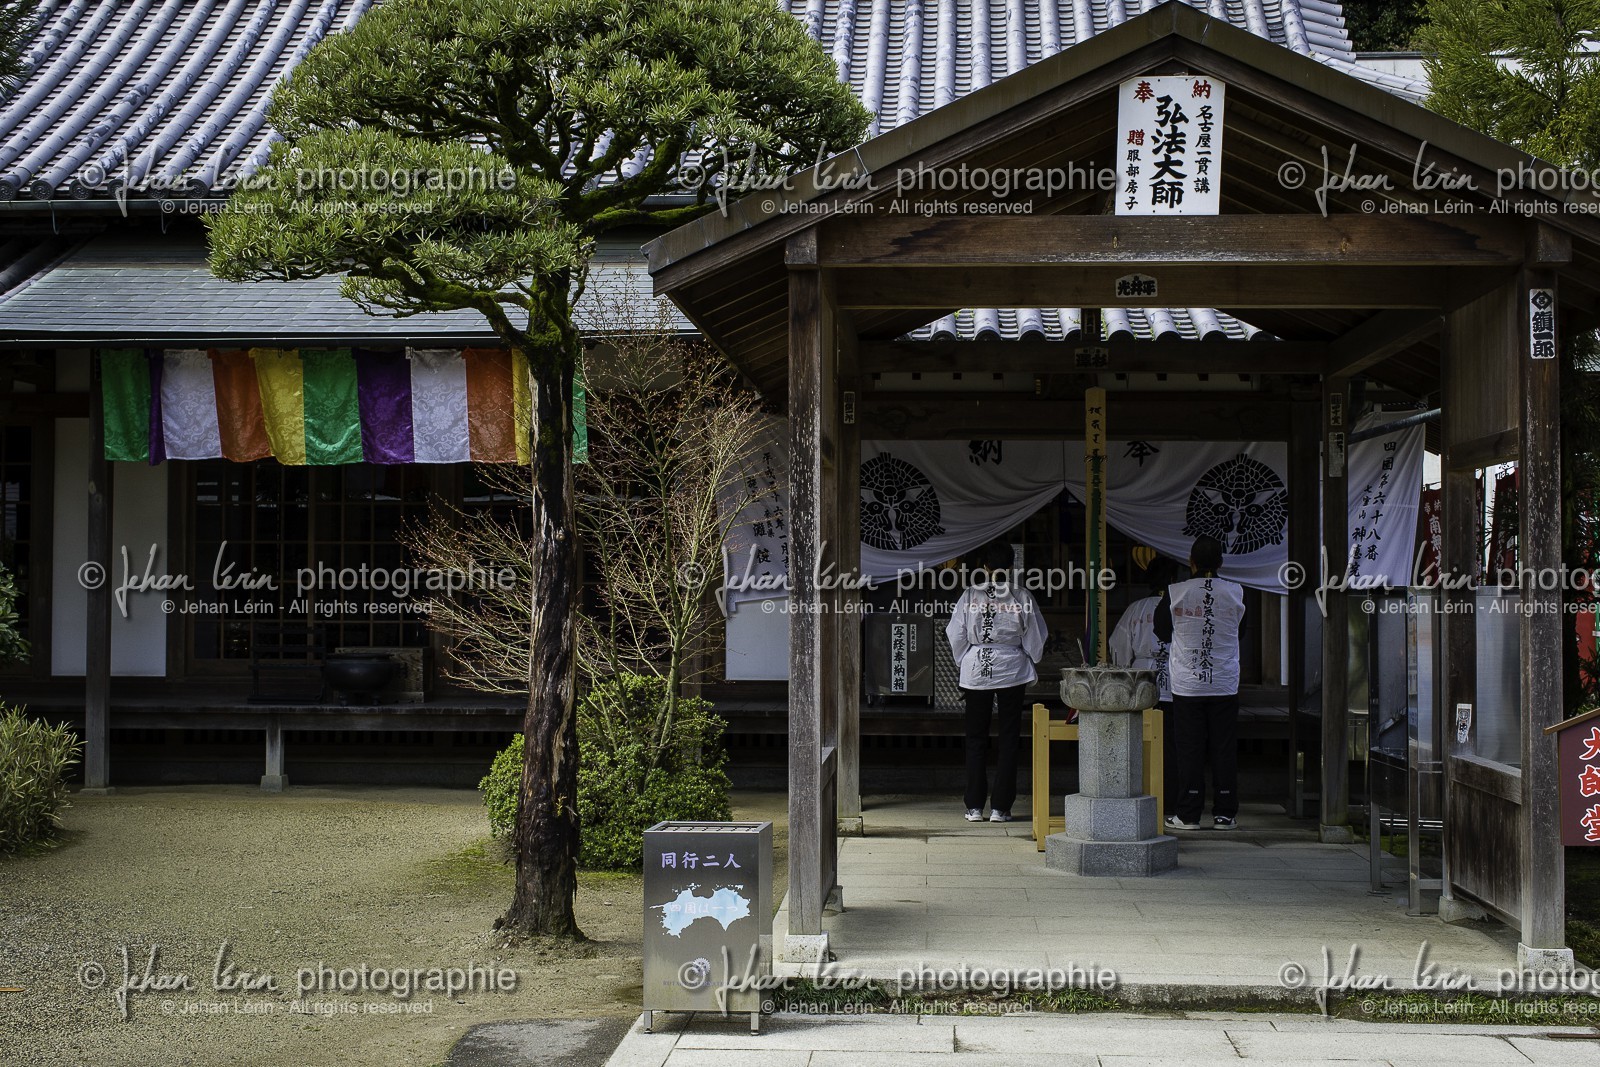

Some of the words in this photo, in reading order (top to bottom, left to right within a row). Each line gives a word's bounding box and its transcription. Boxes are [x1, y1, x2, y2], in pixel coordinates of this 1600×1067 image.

[1149, 95, 1189, 209] 弘法大師
[1193, 105, 1214, 194] 名古屋一貫講
[661, 851, 742, 869] 同行二人
